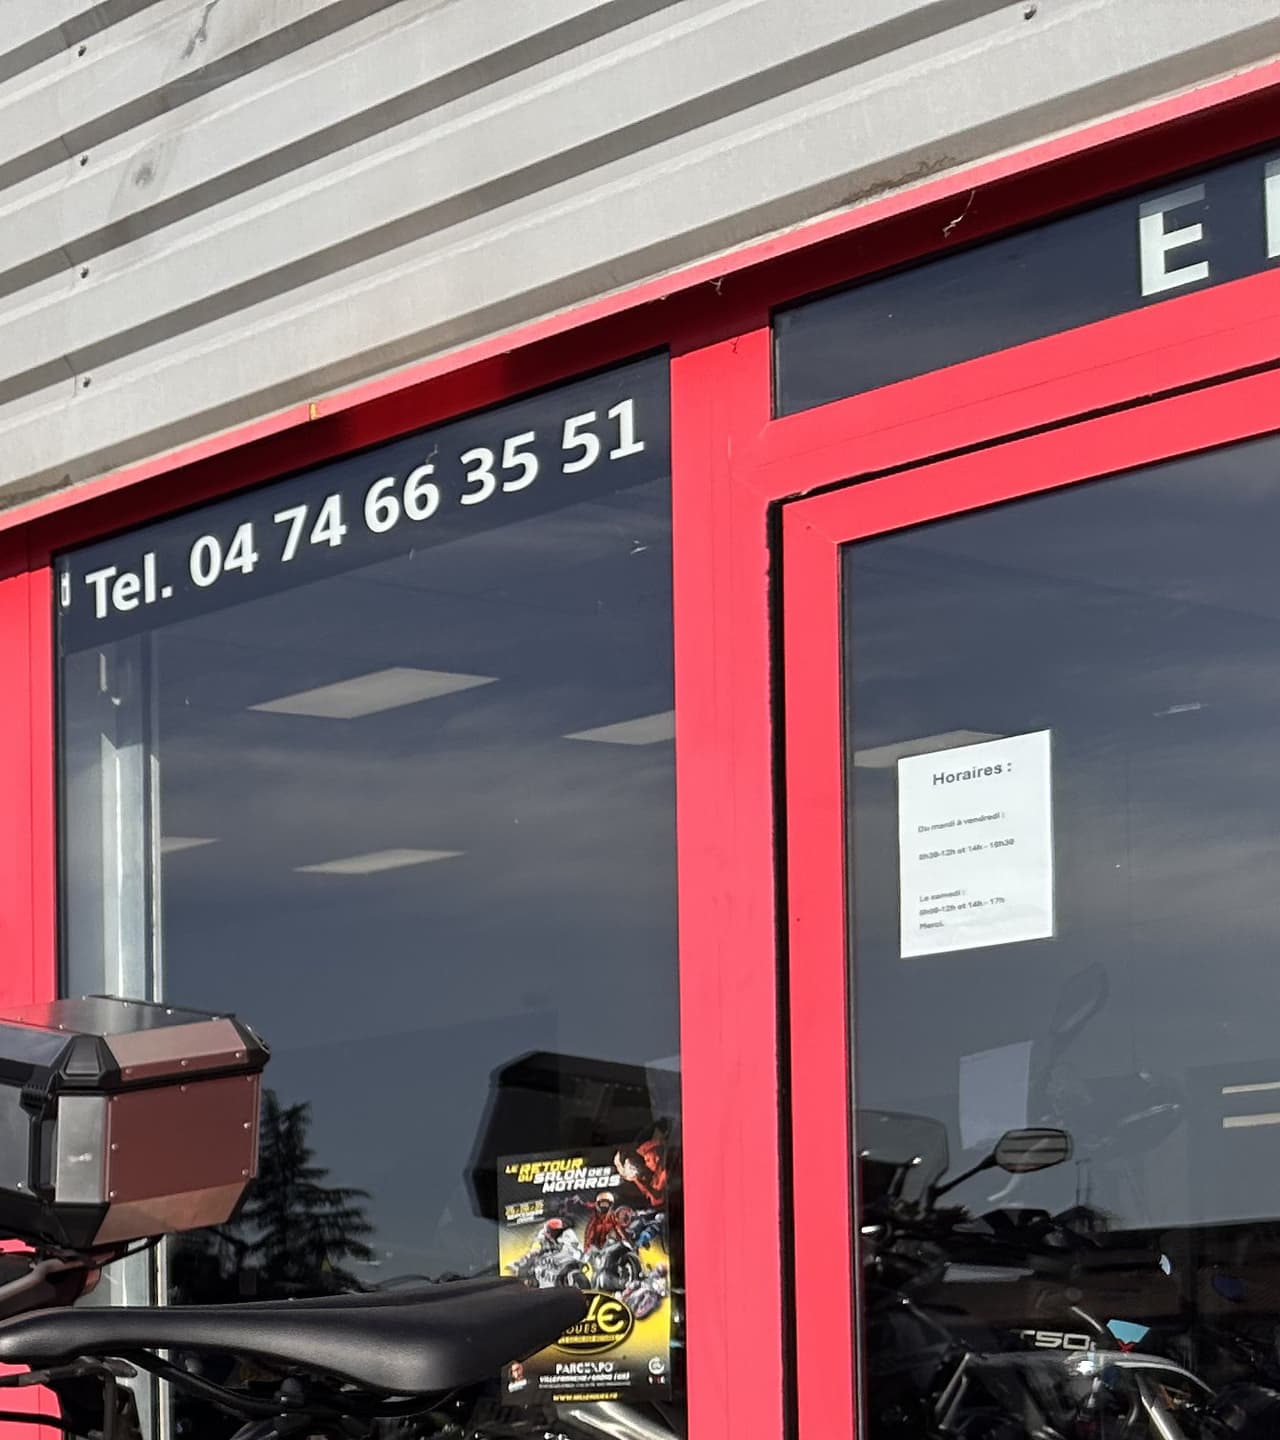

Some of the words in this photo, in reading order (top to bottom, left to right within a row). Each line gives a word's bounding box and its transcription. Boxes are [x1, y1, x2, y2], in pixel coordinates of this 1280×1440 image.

[85, 553, 173, 619] Tel.
[189, 524, 258, 588] 04
[274, 496, 346, 561] 74
[365, 464, 440, 533] 66
[460, 431, 539, 505] 35
[562, 399, 645, 474] 51
[933, 763, 1002, 785] Horaires
[519, 1157, 584, 1176] RETOUR
[533, 1167, 587, 1184] SALON
